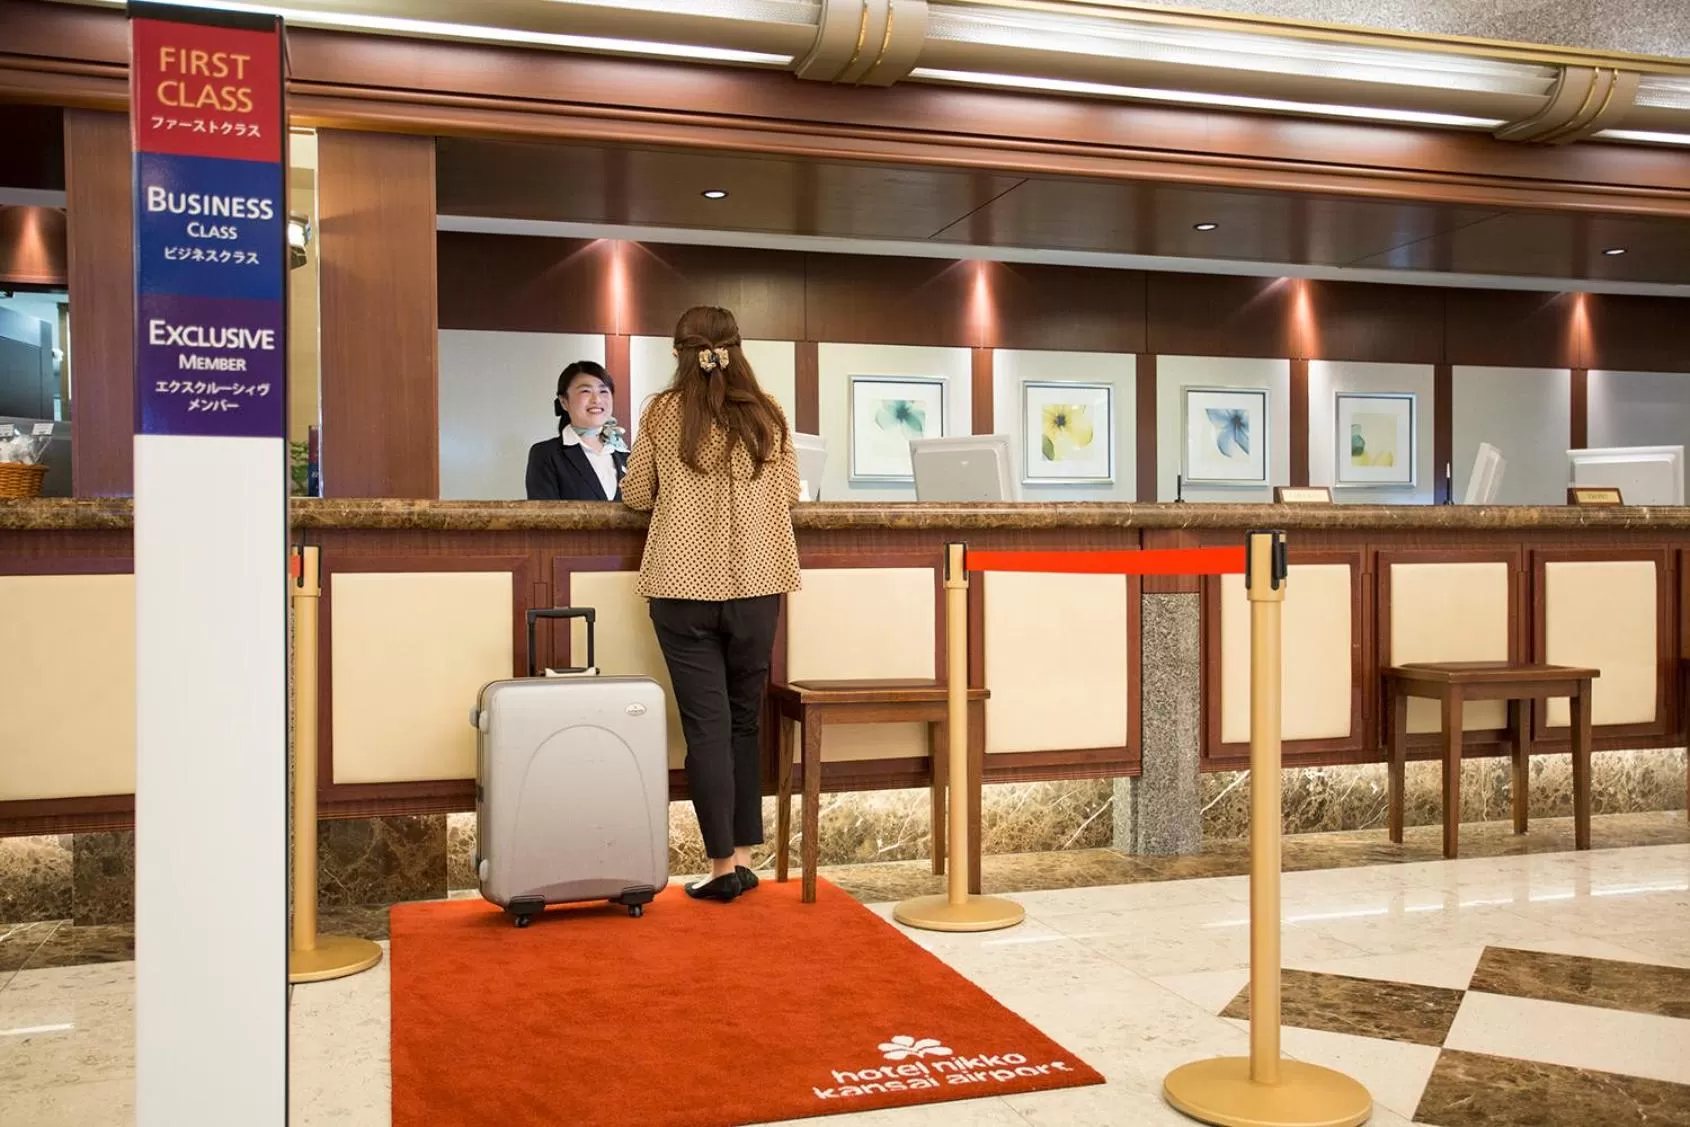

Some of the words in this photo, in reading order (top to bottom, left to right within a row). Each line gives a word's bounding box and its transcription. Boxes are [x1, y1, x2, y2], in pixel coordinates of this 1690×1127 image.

[159, 46, 251, 80] FIRST
[157, 80, 253, 113] CLASS
[151, 116, 261, 138] ファーストクラス
[147, 186, 274, 220] BUSINESS
[187, 222, 238, 240] CLASS
[164, 246, 260, 265] ビジネスクラス
[149, 319, 275, 350] EXCLUSIVE
[178, 353, 247, 372] MEMBER
[155, 380, 271, 397] エクスクルーシィヴ
[187, 399, 240, 412] メンバー
[812, 1074, 941, 1099] kansai
[945, 1061, 1074, 1085] airport
[831, 1061, 930, 1083] hotel
[931, 1053, 1027, 1072] nikko
